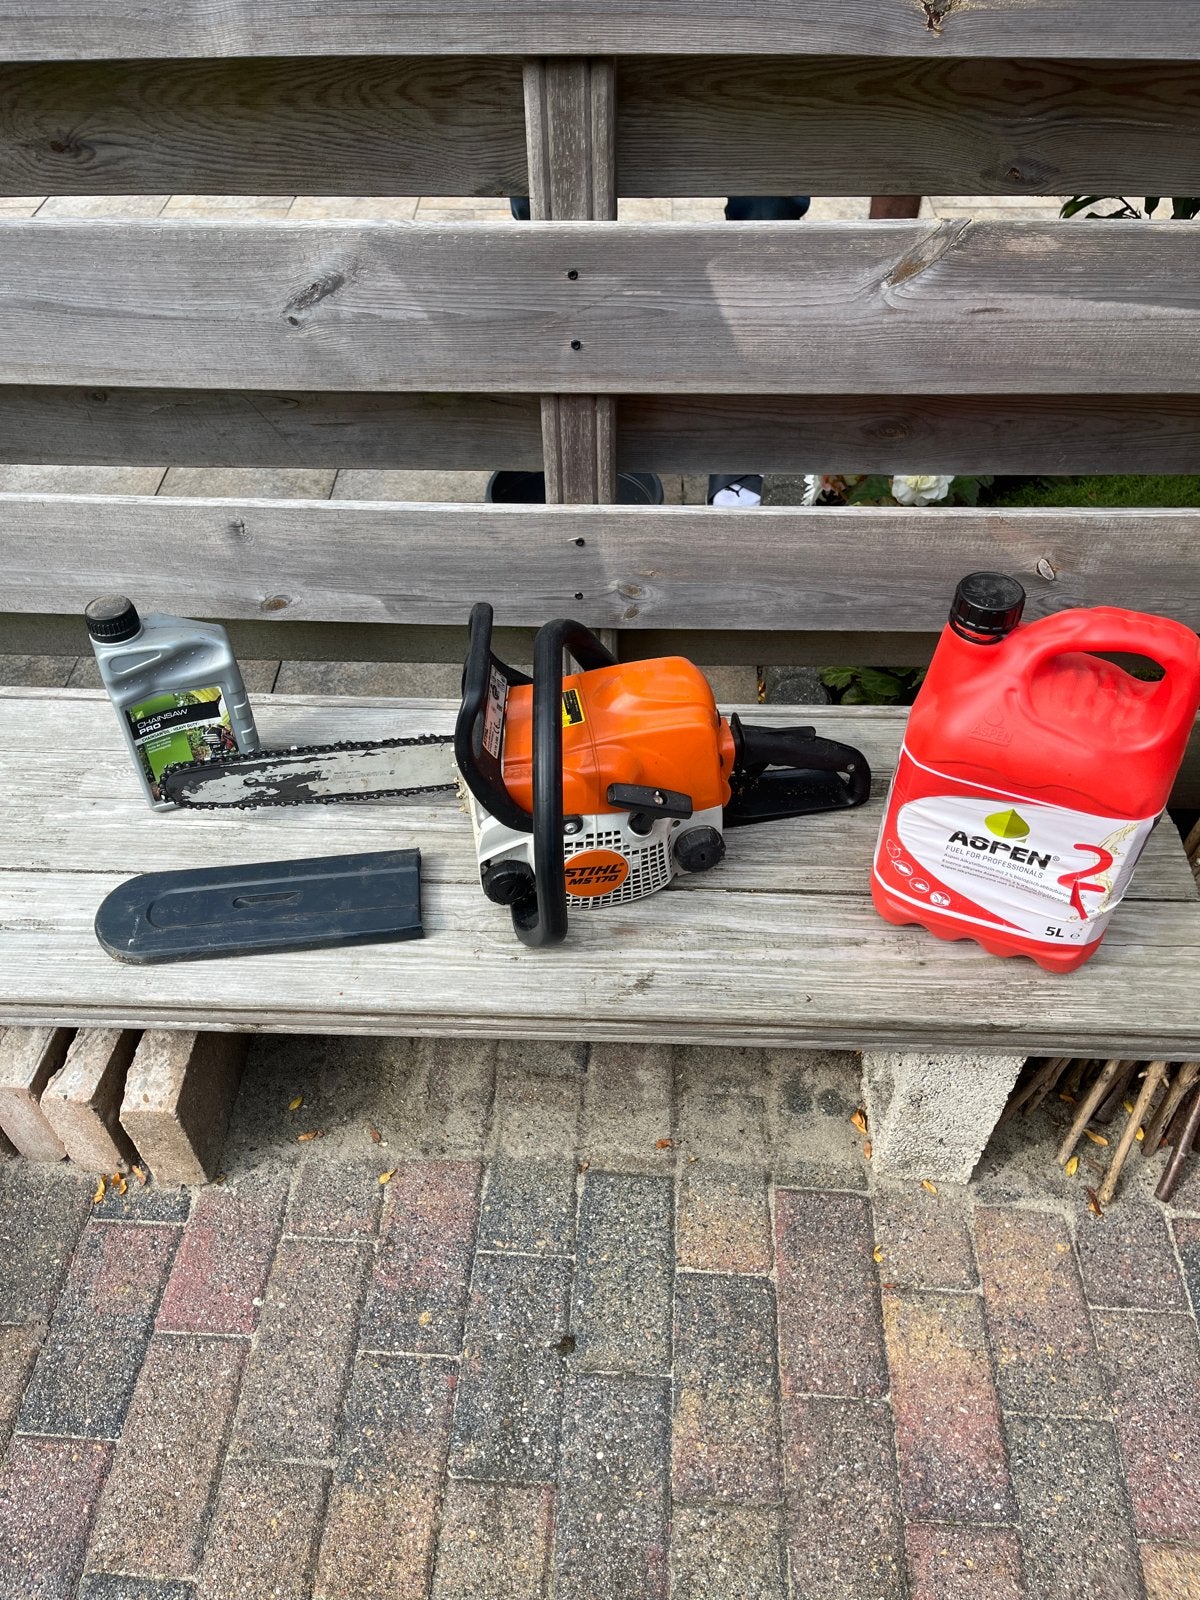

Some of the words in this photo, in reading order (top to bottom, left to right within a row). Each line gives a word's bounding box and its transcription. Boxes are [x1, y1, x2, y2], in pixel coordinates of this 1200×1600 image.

[137, 708, 188, 729] CHAINSAW
[139, 722, 161, 735] PRO
[970, 724, 1013, 744] ASPEN
[945, 845, 964, 856] FUEL
[966, 850, 981, 860] FOR
[982, 855, 1044, 879] PROFESSIONALS
[565, 863, 622, 877] STIHL
[568, 877, 593, 886] MS
[595, 874, 619, 884] 170
[1045, 926, 1065, 938] 5L
